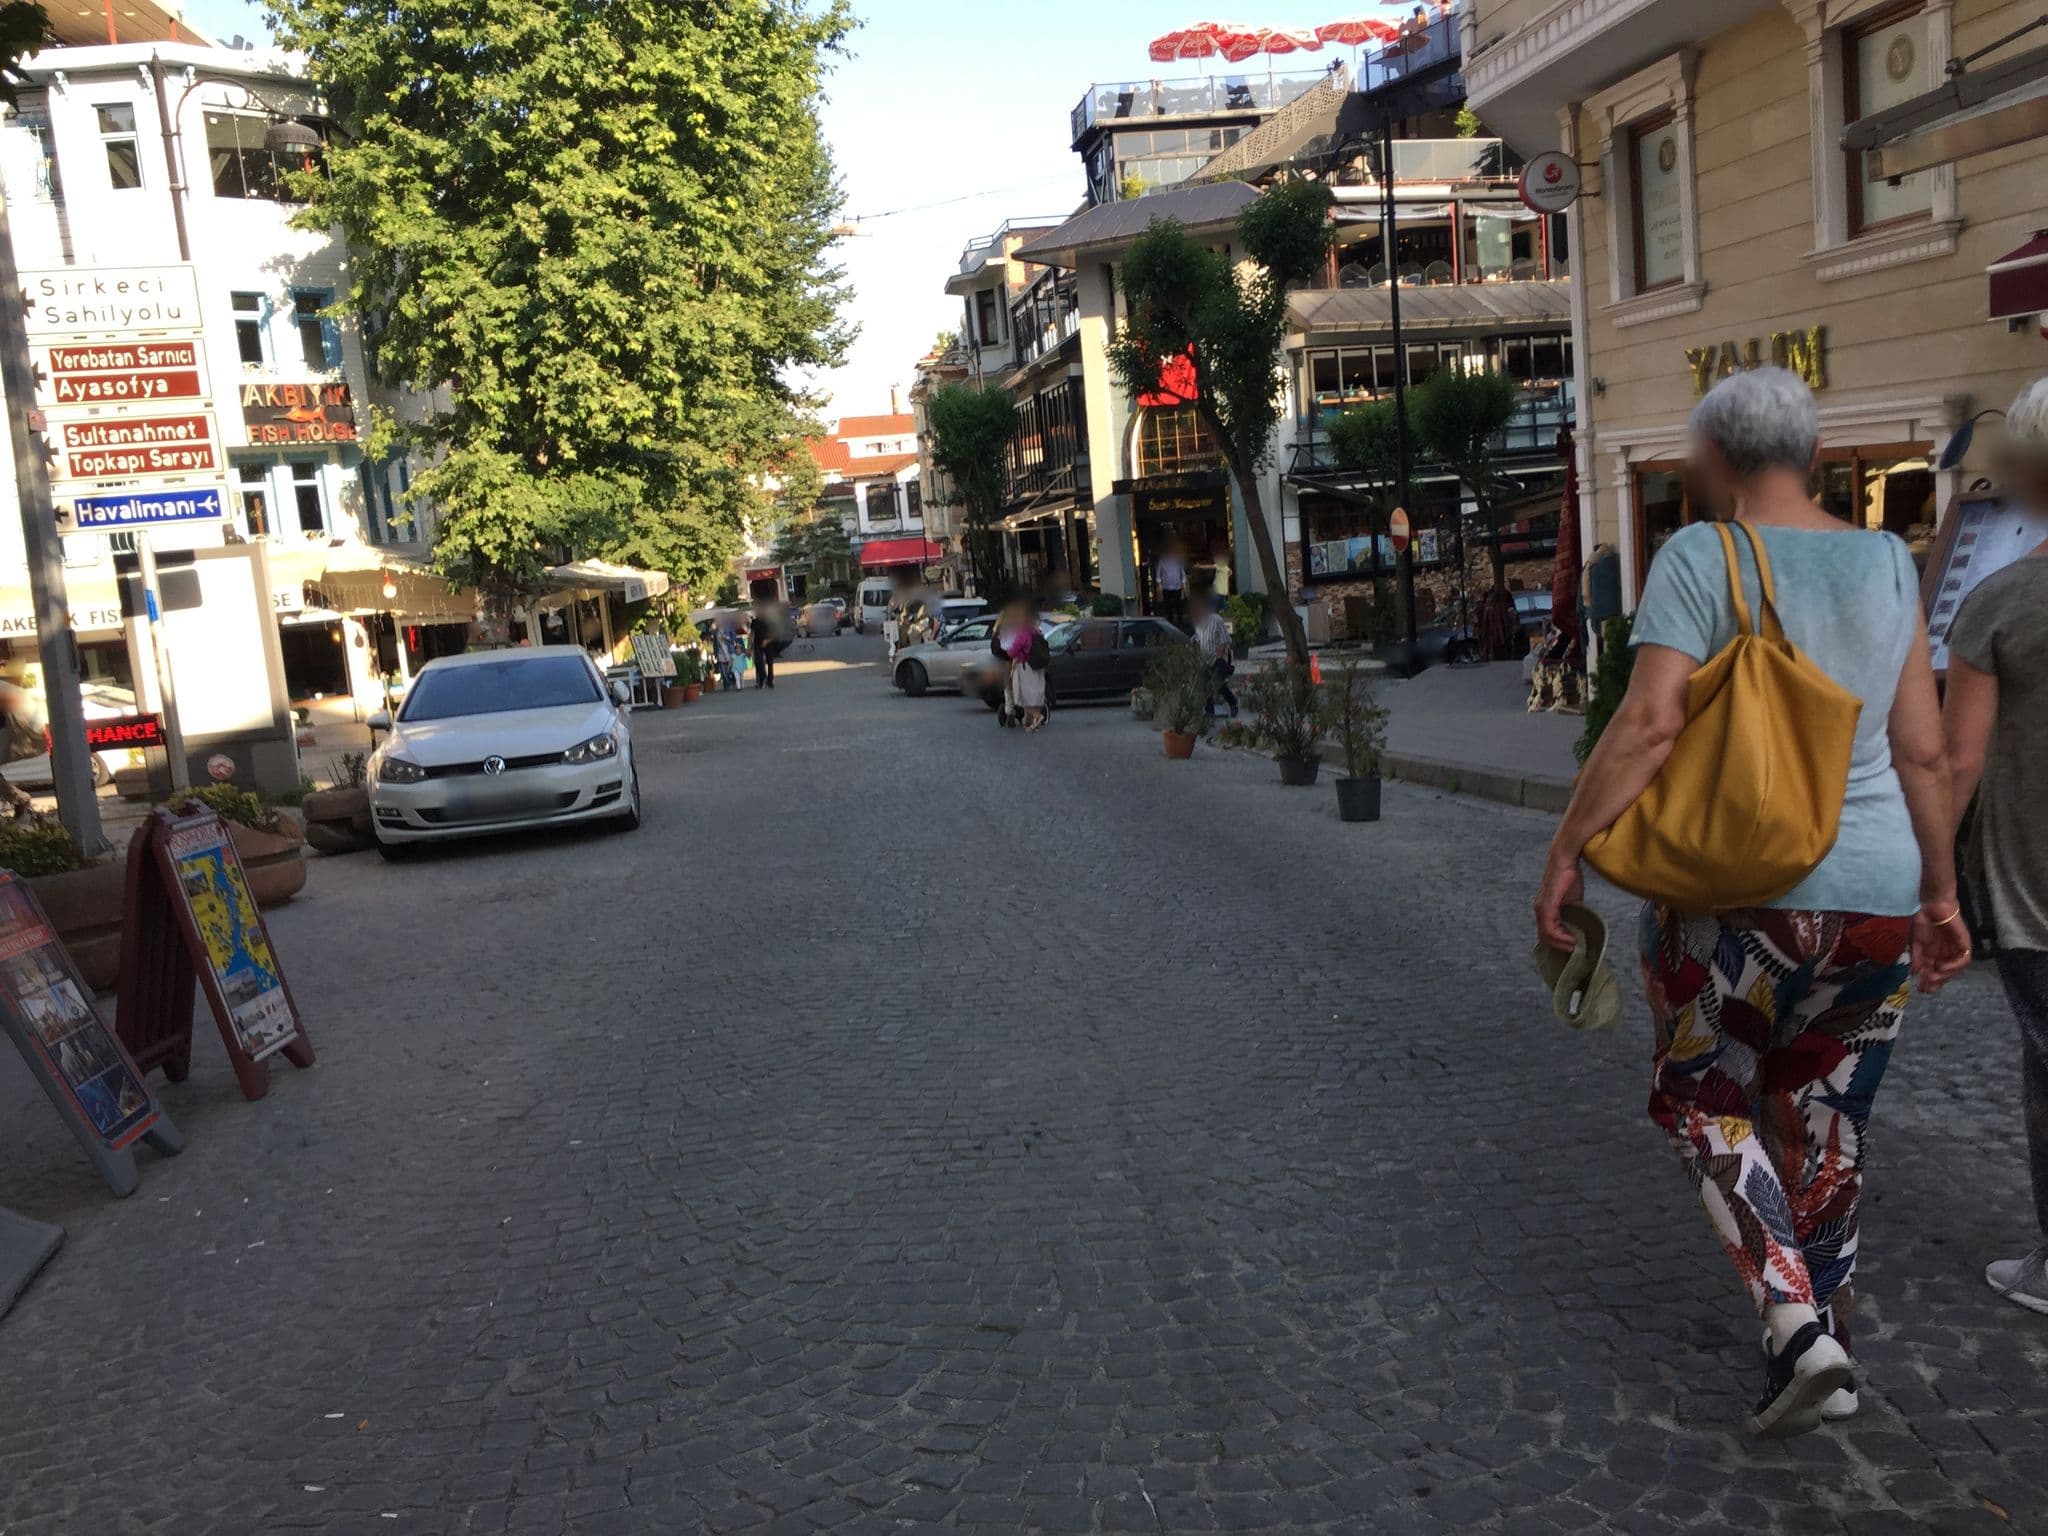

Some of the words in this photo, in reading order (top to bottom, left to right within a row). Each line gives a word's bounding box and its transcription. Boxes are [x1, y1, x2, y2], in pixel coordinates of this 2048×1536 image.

[40, 276, 163, 297] Sirkeci
[45, 302, 181, 326] Sahilyolu
[52, 349, 134, 369] Yerebatan
[138, 346, 193, 367] Sarnıcı
[58, 375, 169, 401] Ayasofya
[66, 421, 197, 447] Sultanahmet
[247, 424, 291, 443] FISH
[295, 422, 357, 442] HOUSE
[70, 452, 145, 475] Topkapı
[149, 449, 209, 469] Sarayı
[77, 499, 195, 523] Havalimanı
[89, 609, 119, 625] FIS
